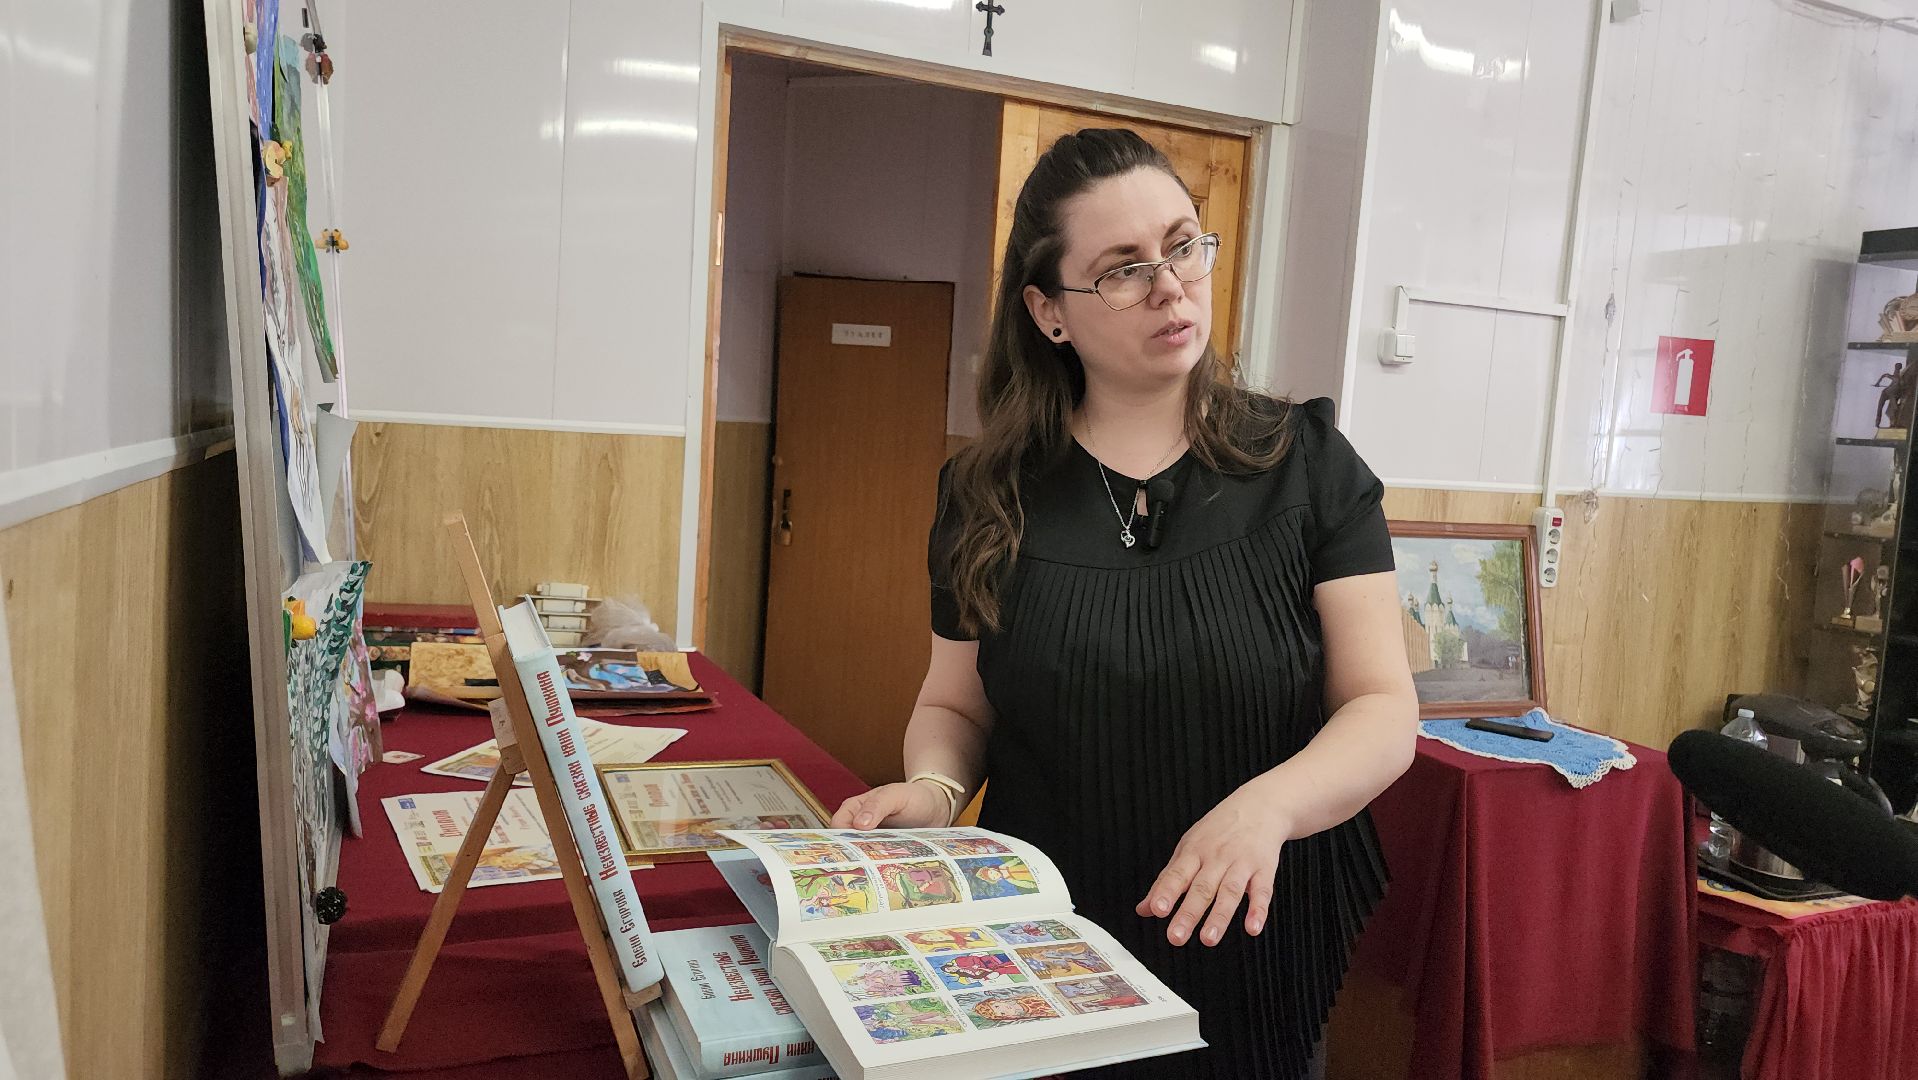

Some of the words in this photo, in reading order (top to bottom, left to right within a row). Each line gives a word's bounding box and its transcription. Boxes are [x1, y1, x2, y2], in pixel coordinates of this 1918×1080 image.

[536, 670, 566, 728] Пушкина
[556, 727, 577, 758] няни
[567, 760, 592, 802] сказки
[583, 803, 618, 881] Неизвестные
[612, 888, 636, 934] Егорова
[729, 934, 762, 966] Пушкина
[712, 951, 755, 1002] Неизвестные
[723, 1045, 780, 1067] Пушкина
